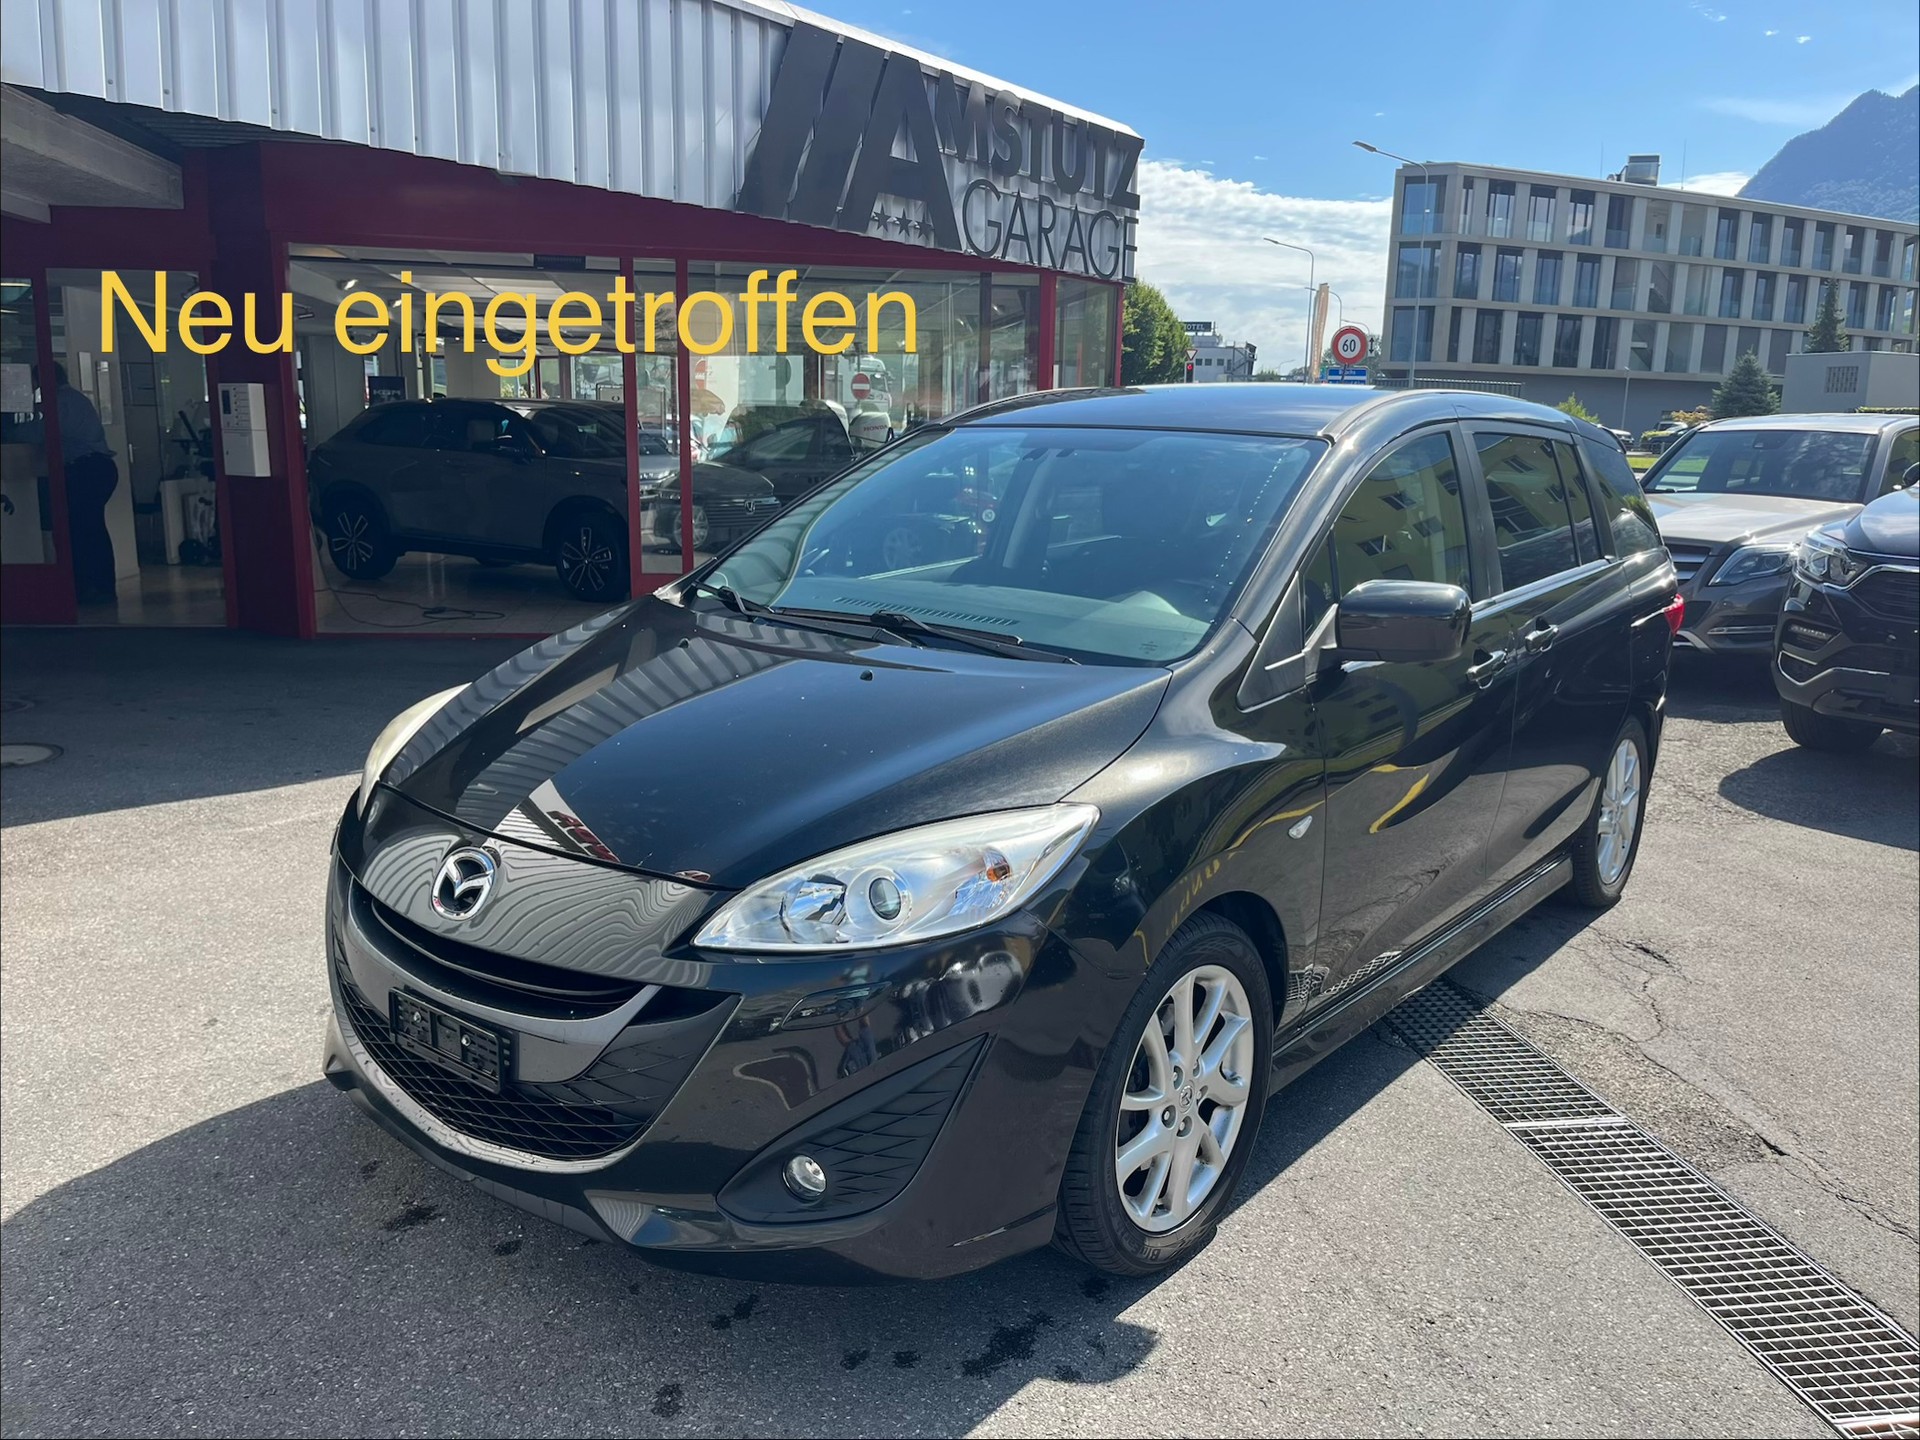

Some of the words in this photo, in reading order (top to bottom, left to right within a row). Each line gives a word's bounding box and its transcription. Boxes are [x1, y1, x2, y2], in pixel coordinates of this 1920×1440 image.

[836, 50, 1145, 252] AMSTUTZ
[962, 178, 1139, 284] GARAGE
[1342, 338, 1357, 354] 60
[863, 424, 888, 432] HONDA
